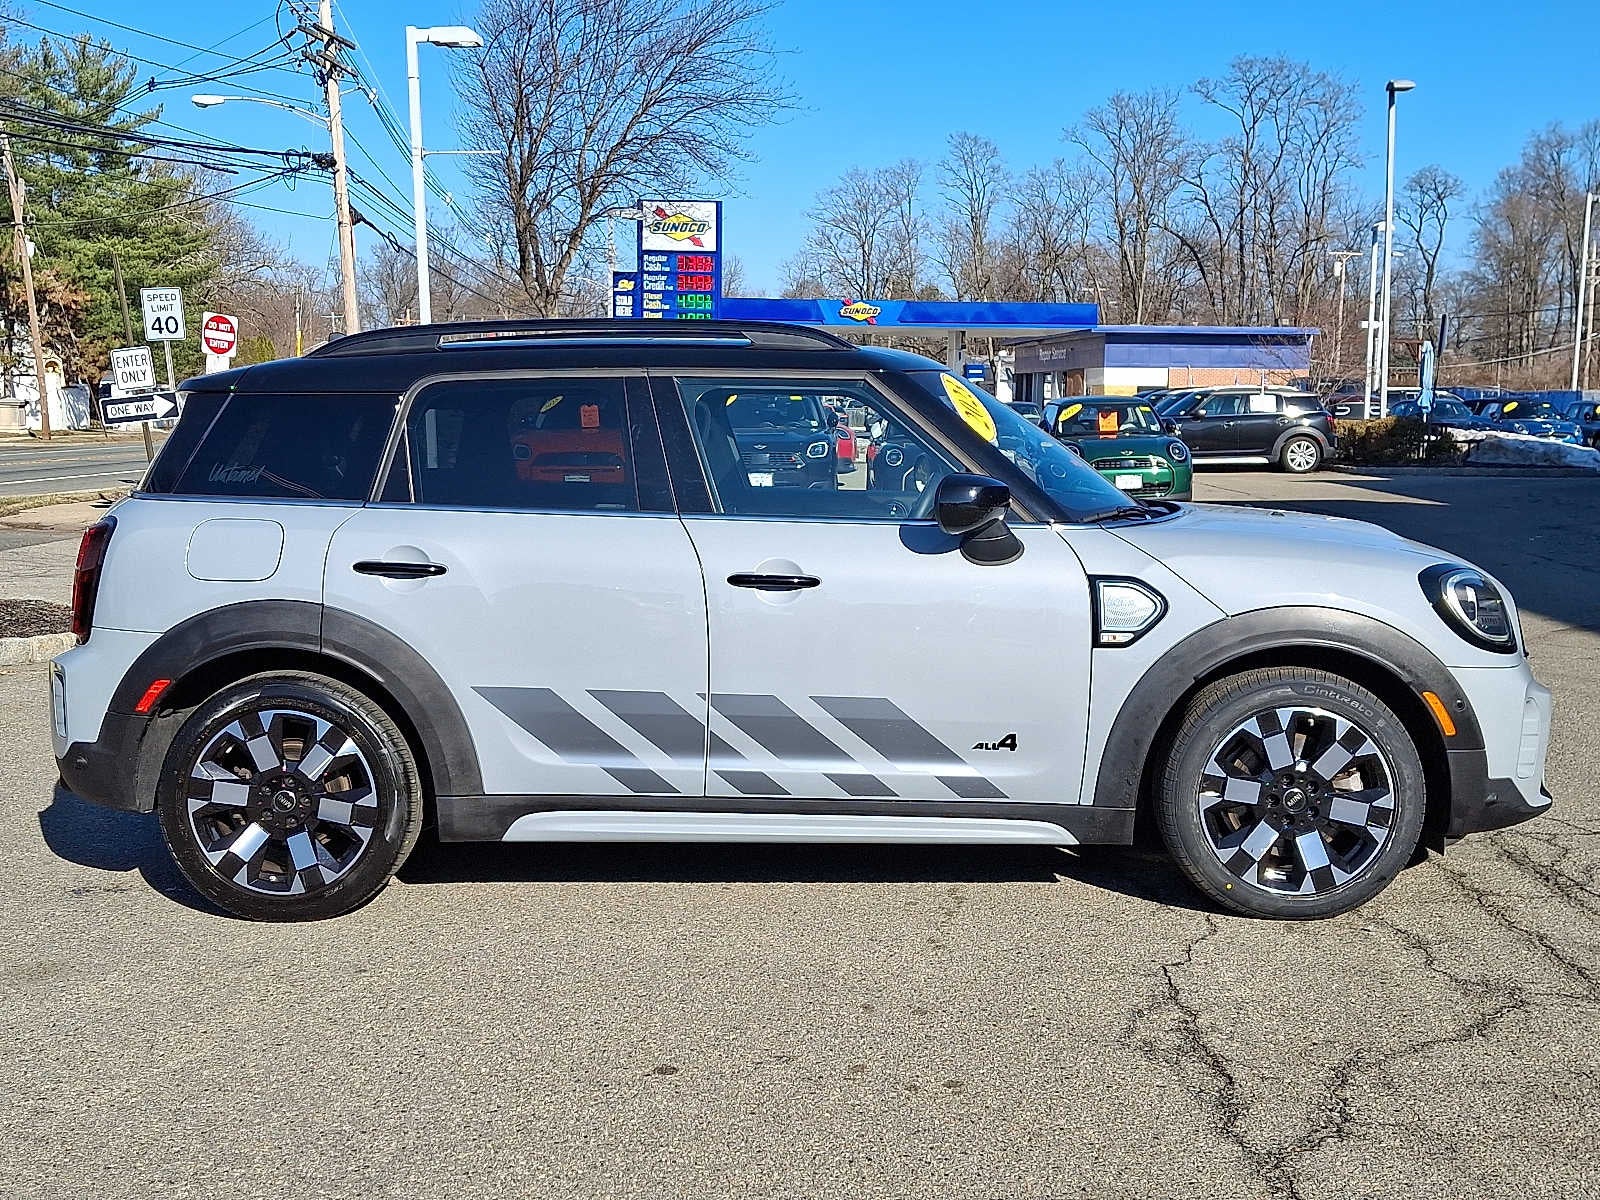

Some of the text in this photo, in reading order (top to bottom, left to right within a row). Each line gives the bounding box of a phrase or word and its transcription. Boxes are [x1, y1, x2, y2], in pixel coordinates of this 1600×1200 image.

[652, 222, 706, 233] SUNOCO
[643, 262, 661, 271] Cash
[643, 281, 665, 290] Credit
[146, 293, 177, 302] SPEED
[151, 303, 174, 312] LIMIT
[643, 300, 661, 309] Cash
[842, 307, 879, 315] SUNOCO
[151, 316, 179, 334] 40
[208, 321, 231, 332] DO NOT
[209, 340, 229, 350] ENTER
[115, 354, 148, 369] ENTER
[121, 369, 147, 384] ONLY
[110, 402, 156, 416] ONE WAY
[1287, 792, 1303, 807] MINI
